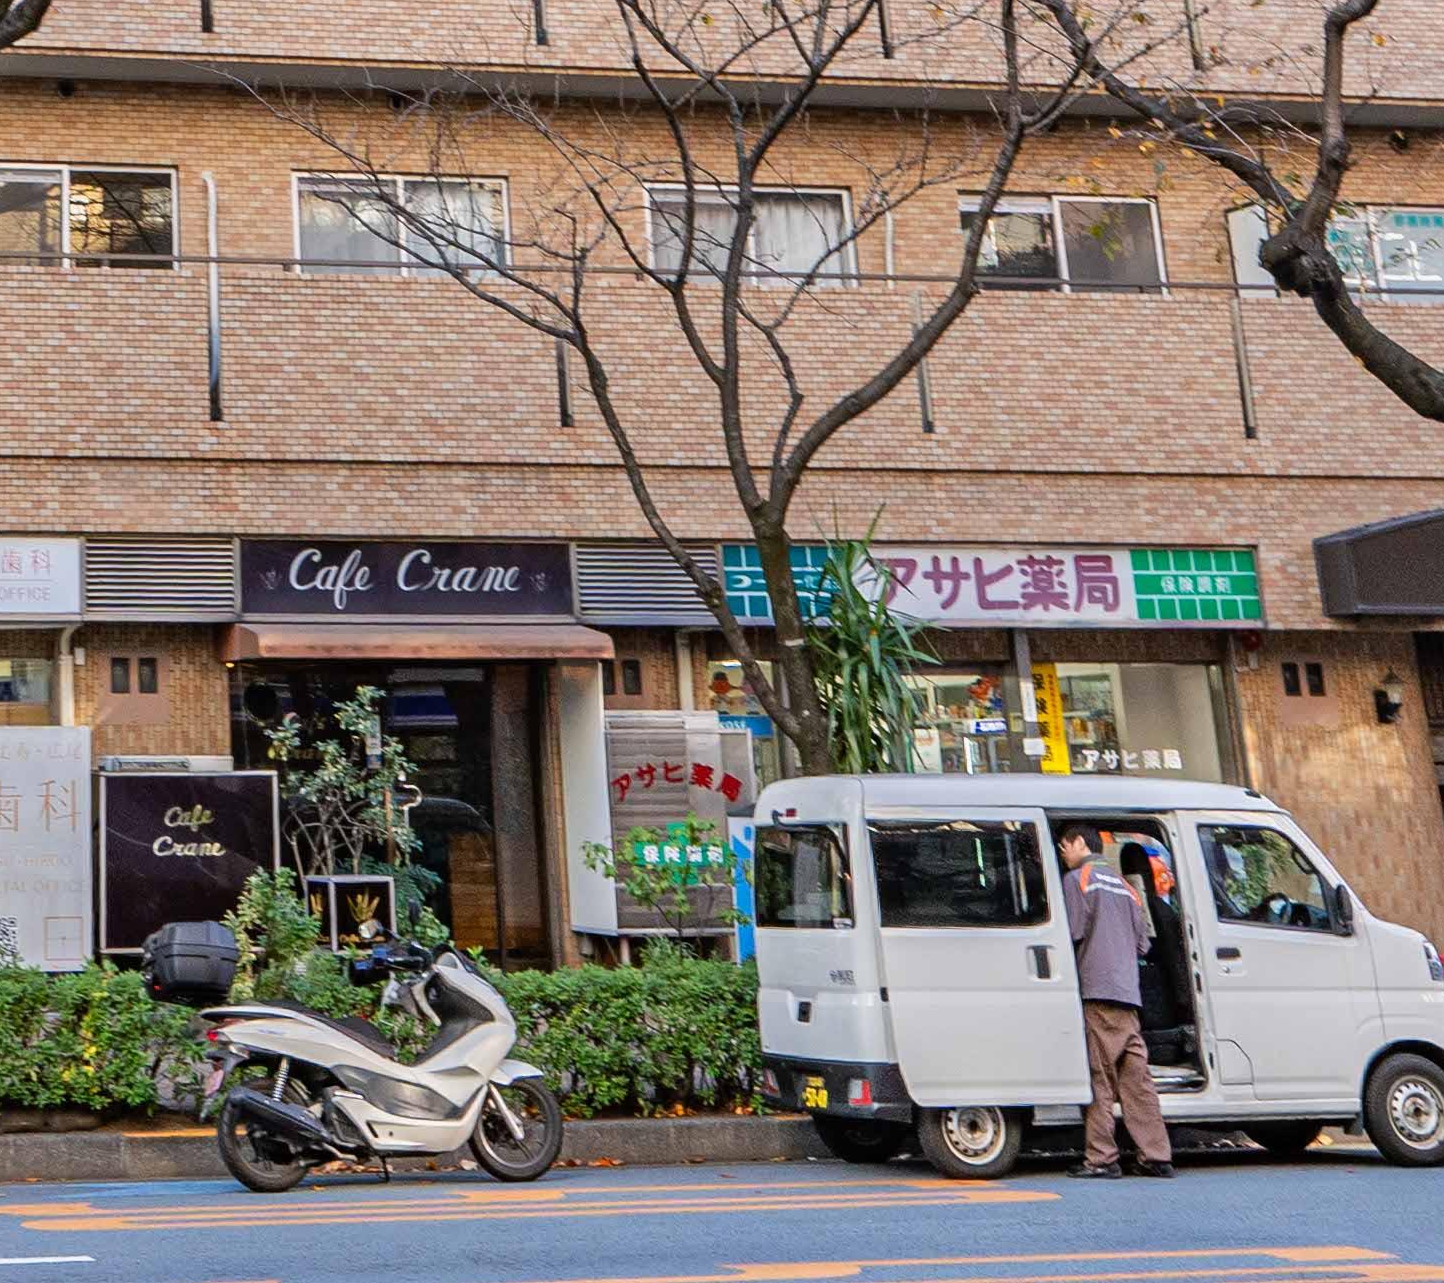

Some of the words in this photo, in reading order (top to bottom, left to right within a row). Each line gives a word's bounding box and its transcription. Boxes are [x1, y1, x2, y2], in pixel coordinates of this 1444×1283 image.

[0, 549, 52, 576] 歯科
[288, 548, 374, 610] Cafe
[396, 548, 521, 592] Crane
[1082, 748, 1183, 770] アサヒ薬局
[163, 803, 215, 832] Cafe
[152, 836, 226, 857] Crane
